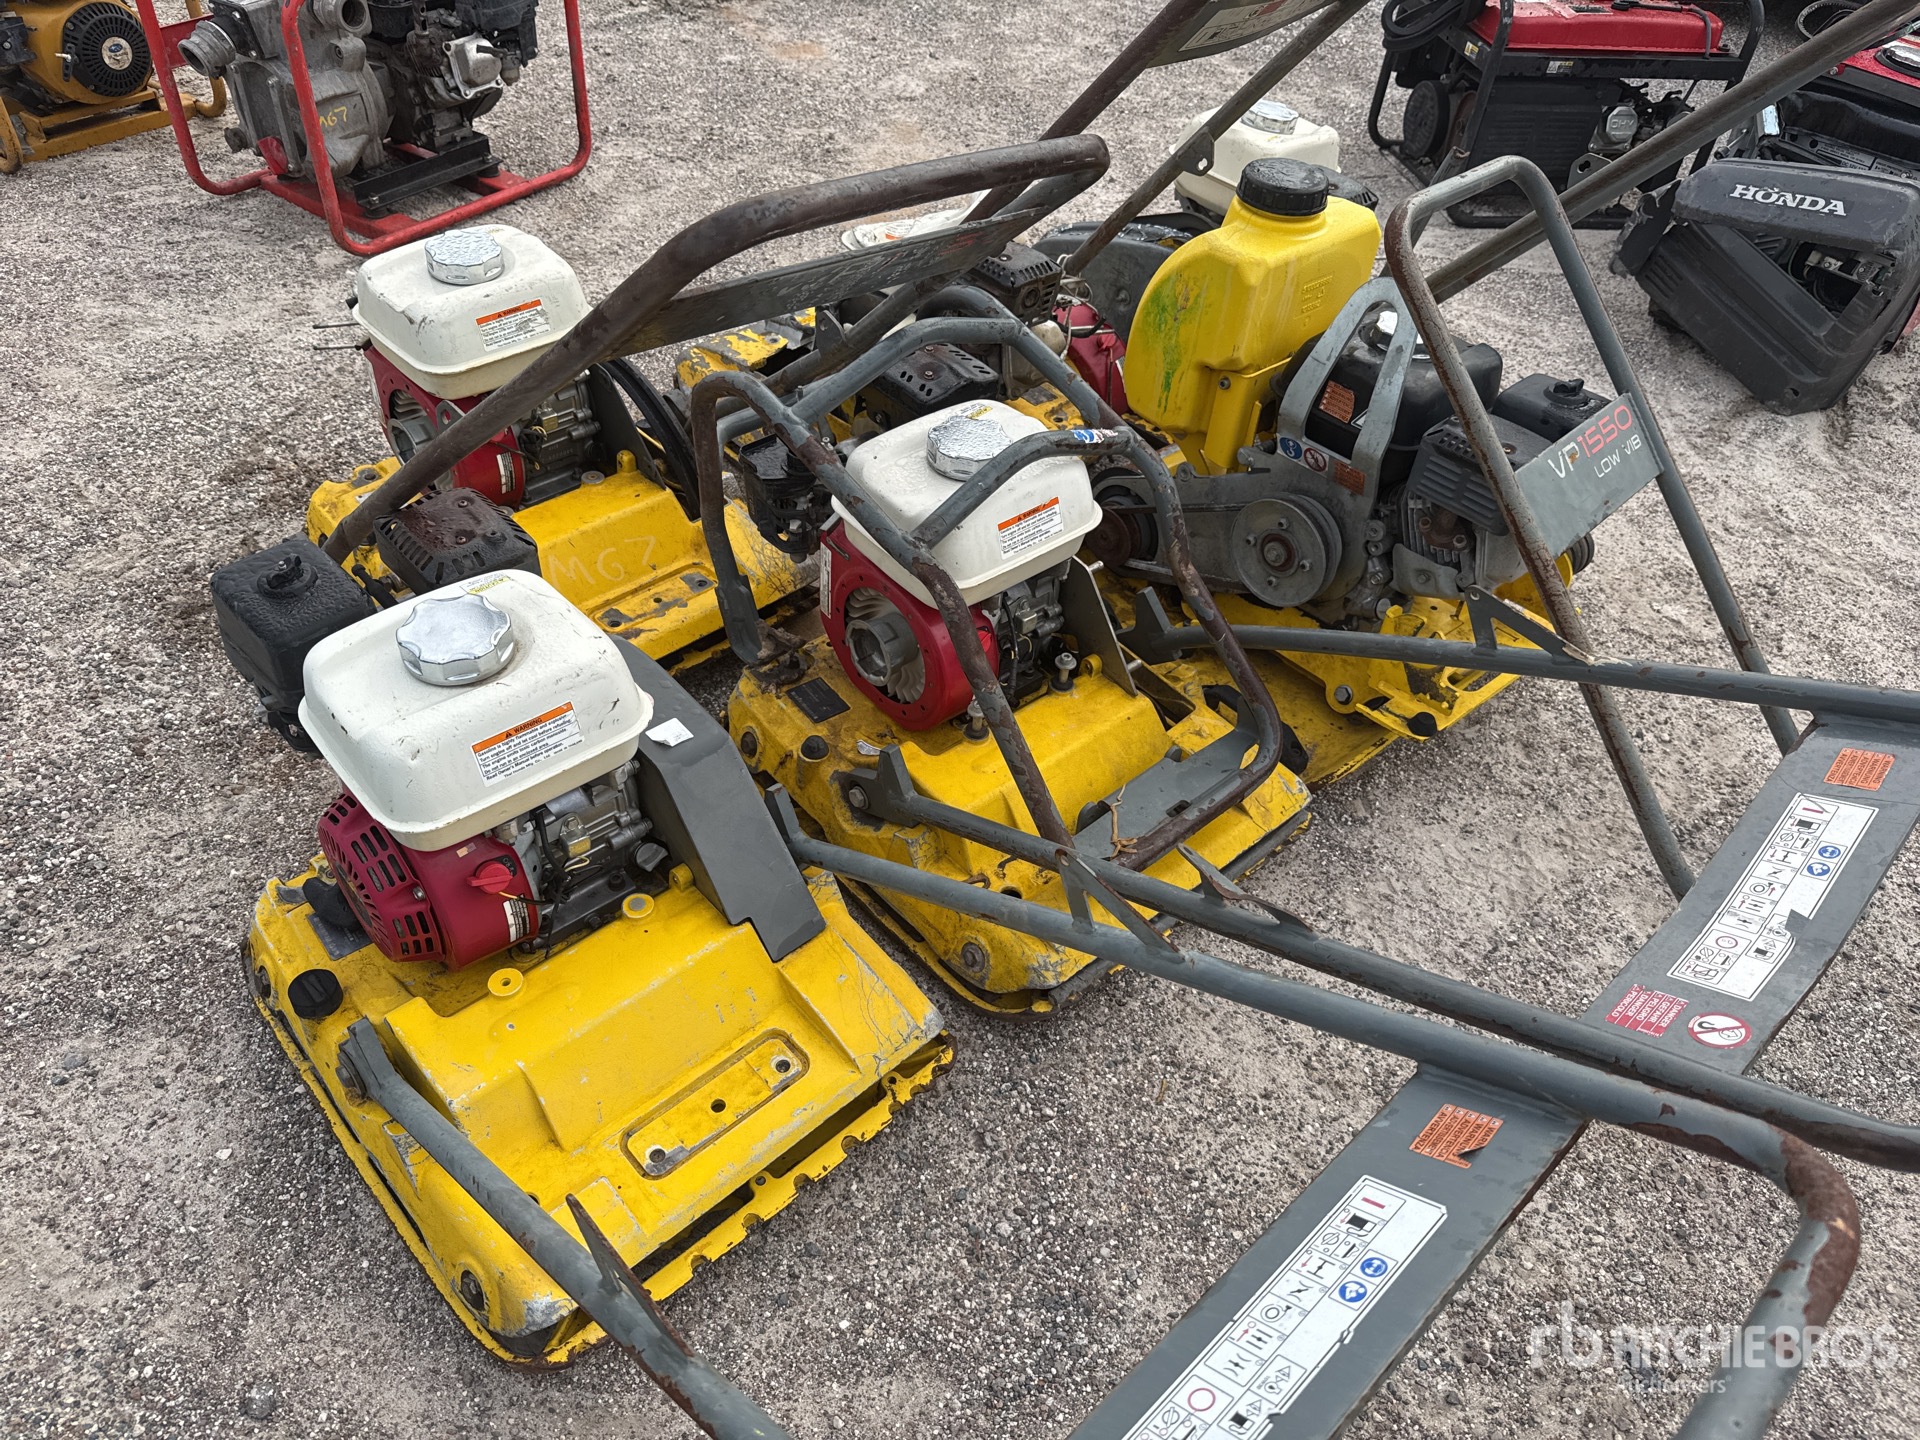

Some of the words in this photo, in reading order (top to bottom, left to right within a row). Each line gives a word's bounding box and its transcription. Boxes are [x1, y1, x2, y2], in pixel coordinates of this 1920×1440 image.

[1730, 184, 1846, 216] HONDA
[1548, 405, 1632, 478] VP1550
[1594, 449, 1620, 478] LOW
[1622, 434, 1642, 454] VIB
[546, 535, 656, 587] M67
[514, 717, 542, 733] WARNING
[478, 746, 496, 758] Gasoline
[480, 755, 490, 763] Turn
[490, 748, 505, 758] engine
[528, 733, 537, 741] cool
[538, 727, 552, 736] before
[486, 772, 497, 780] Read
[498, 764, 514, 775] Owner's
[514, 757, 529, 767] Manual
[530, 751, 543, 760] before
[1611, 991, 1637, 1017] PERICOLO
[1625, 994, 1648, 1016] DANGER
[1635, 997, 1659, 1021] PELIGRO
[1648, 1001, 1670, 1023] GEFAHR
[1658, 1005, 1681, 1027] DANGER
[1412, 1112, 1448, 1150] AVVERTENZA
[1436, 1120, 1471, 1158] ADVERTENCIA
